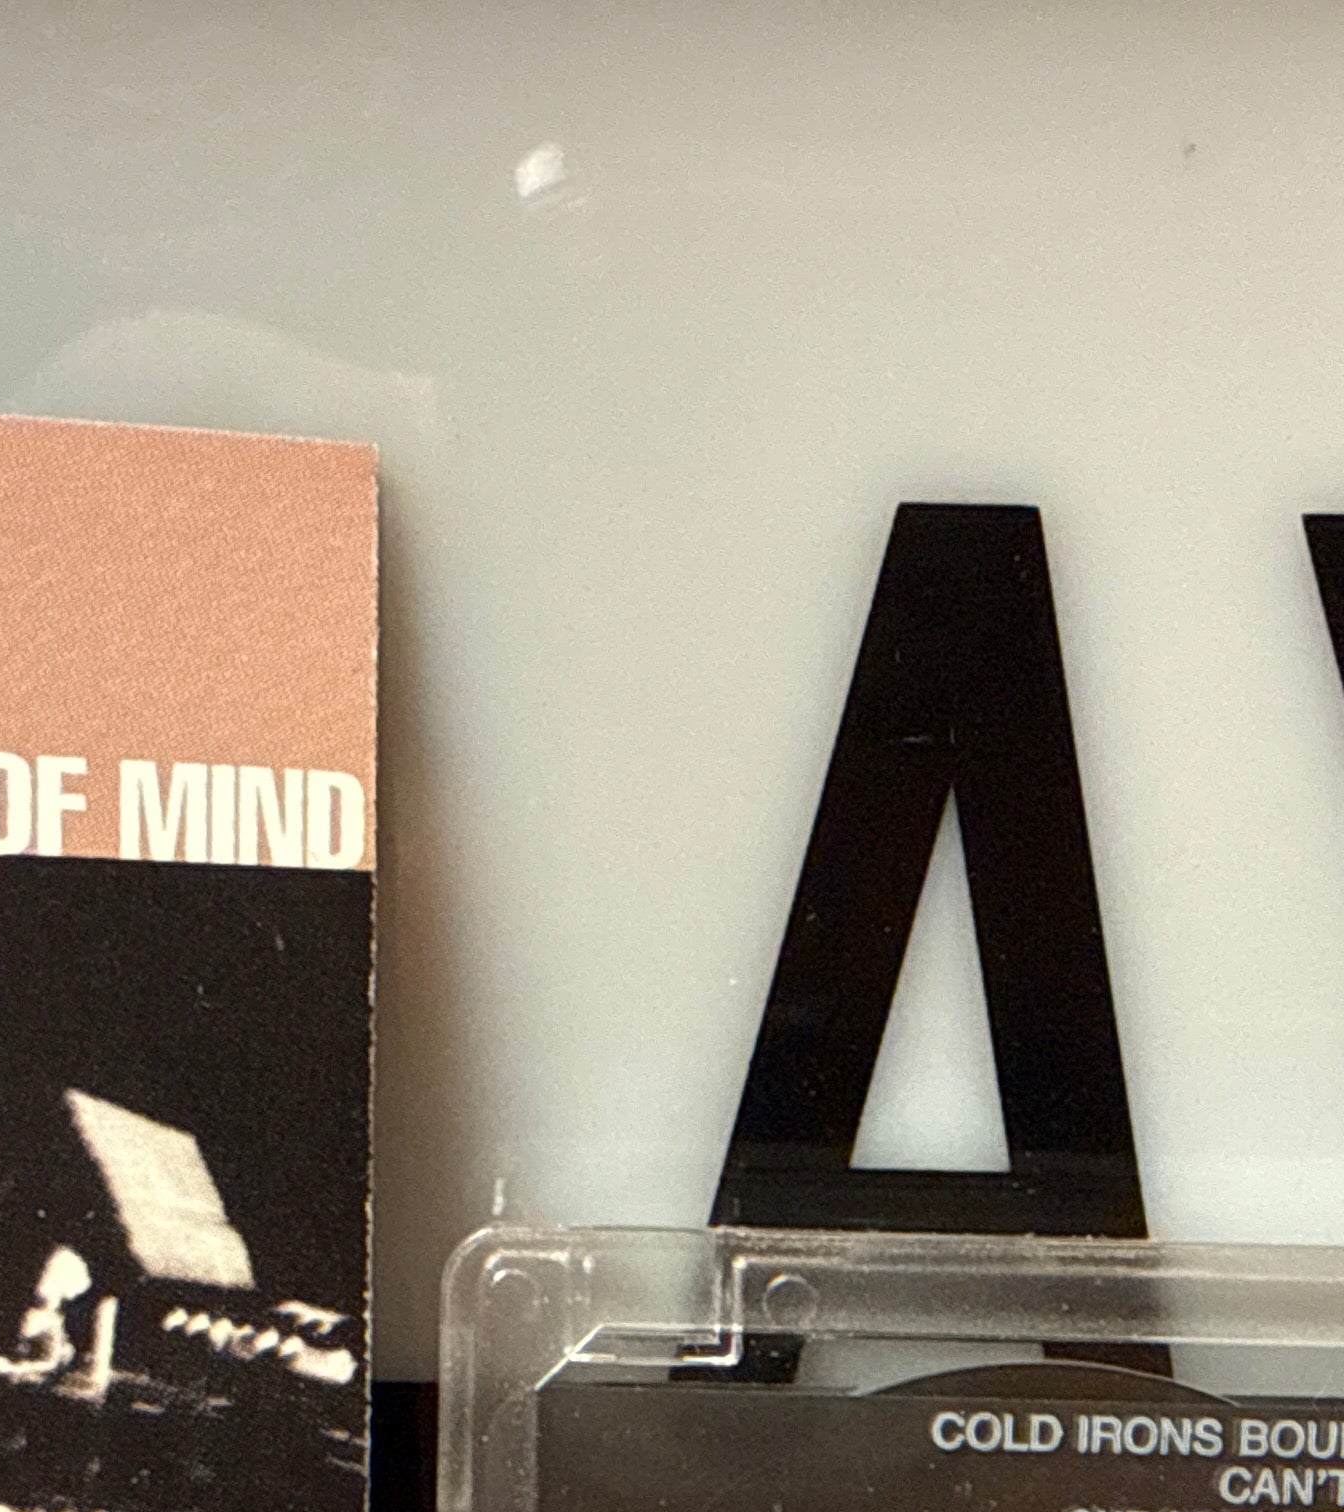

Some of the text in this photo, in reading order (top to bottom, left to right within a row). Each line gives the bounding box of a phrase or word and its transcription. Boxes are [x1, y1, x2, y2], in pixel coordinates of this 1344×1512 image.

[118, 758, 367, 872] MIND
[930, 1411, 1065, 1453] COLD
[1076, 1415, 1224, 1458] IRONS
